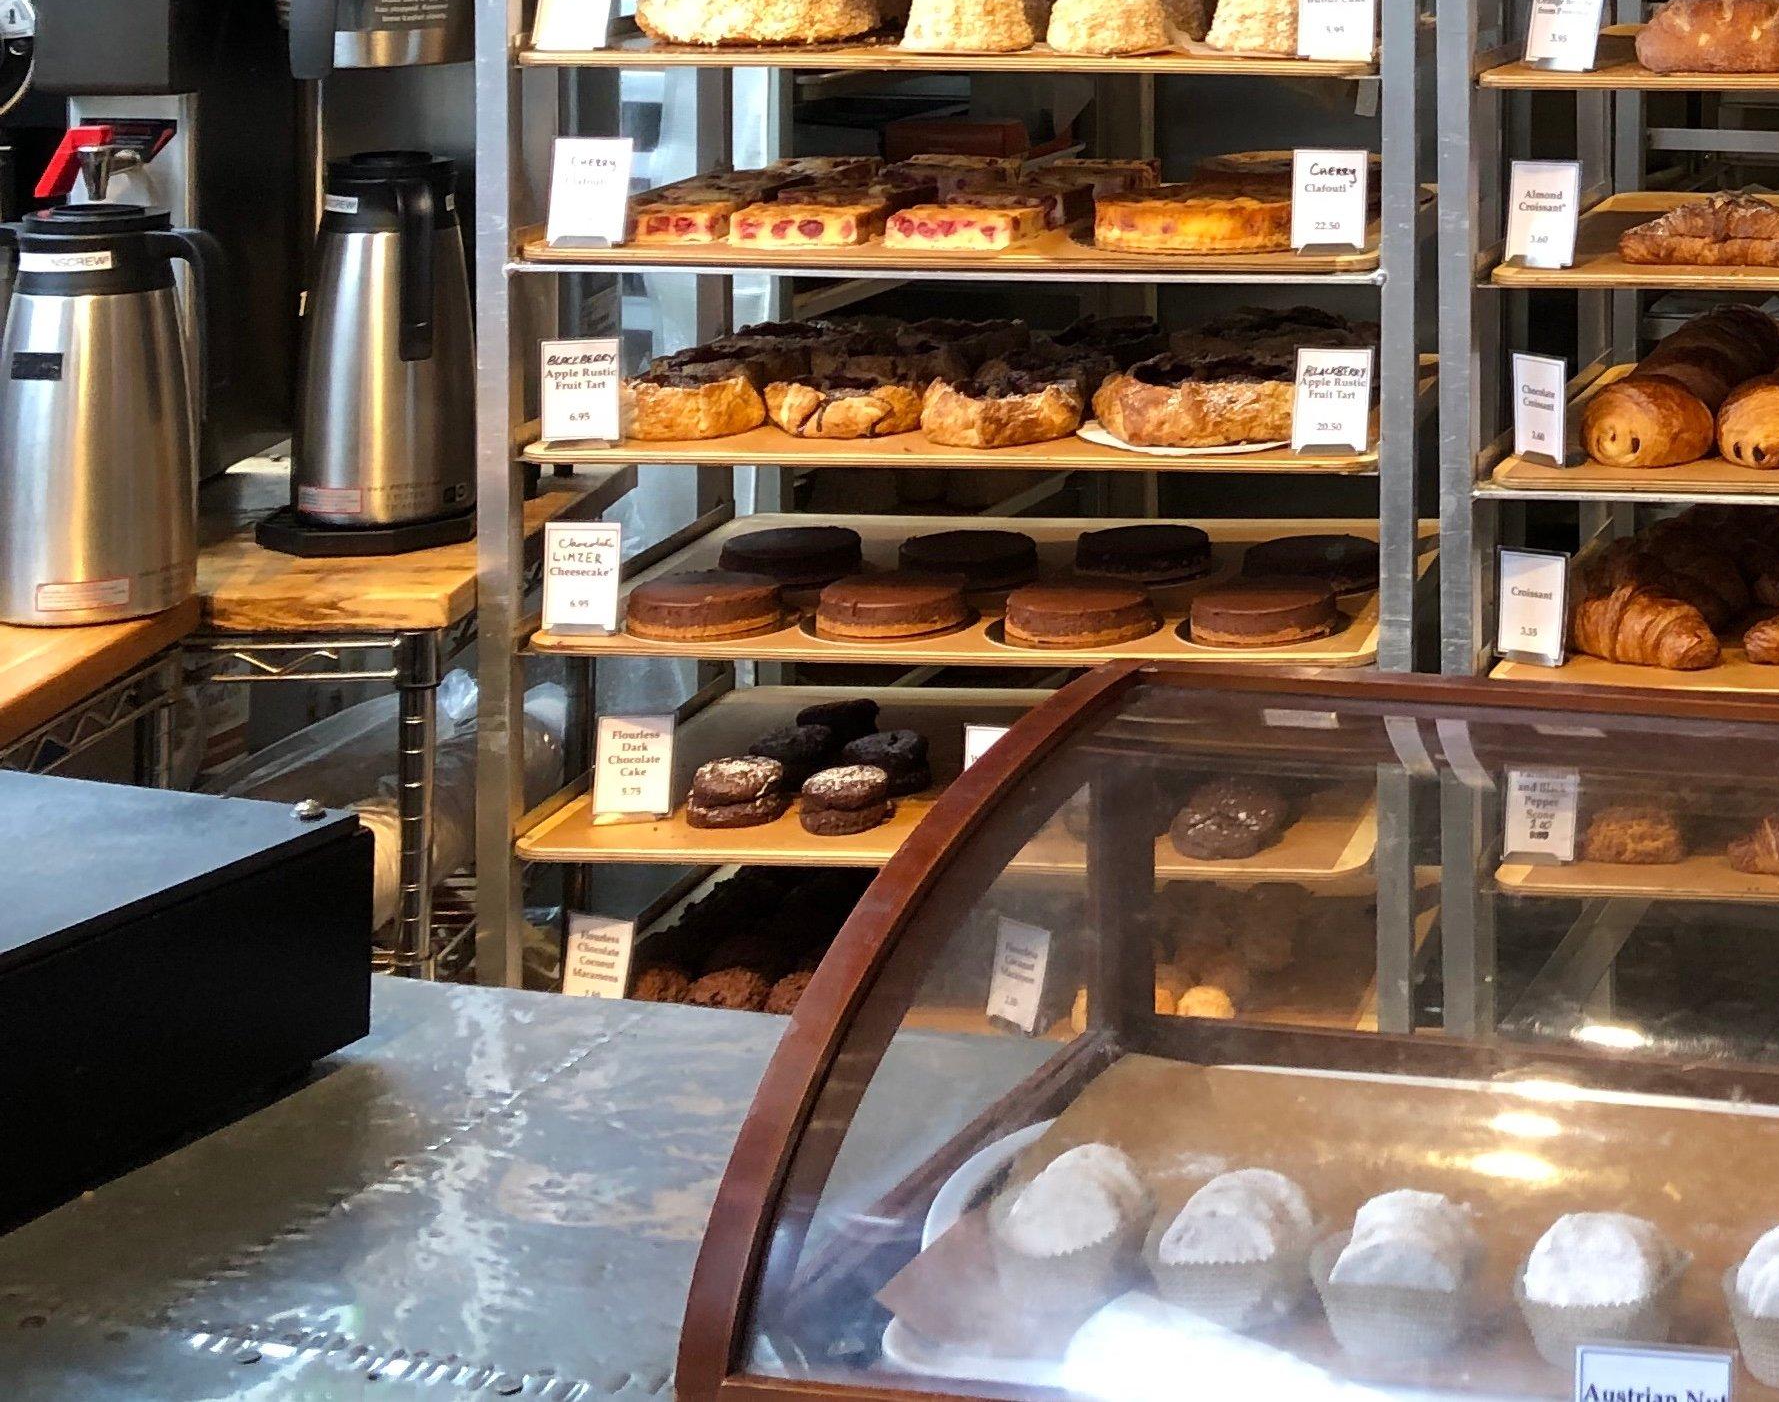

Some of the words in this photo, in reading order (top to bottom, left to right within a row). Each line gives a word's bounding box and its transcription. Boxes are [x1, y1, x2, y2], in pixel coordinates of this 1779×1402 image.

[1304, 183, 1346, 193] Clafouti
[1524, 190, 1563, 200] Almond
[1314, 221, 1341, 231] 22.50
[545, 369, 579, 380] Apple
[582, 366, 616, 377] Rustic
[555, 380, 582, 390] Fruit
[586, 379, 606, 389] Tart
[1300, 378, 1331, 389] Apple
[1334, 378, 1367, 388] Rustic
[1308, 390, 1333, 399] Fruit
[1336, 390, 1355, 399] Tart
[569, 412, 591, 422] 6.95
[1511, 586, 1553, 600] Croissant
[612, 730, 661, 740] Flourless
[621, 742, 648, 752] Dark
[608, 754, 661, 765] Chocolate
[620, 766, 647, 777] Cake
[1524, 796, 1559, 810] Pepper
